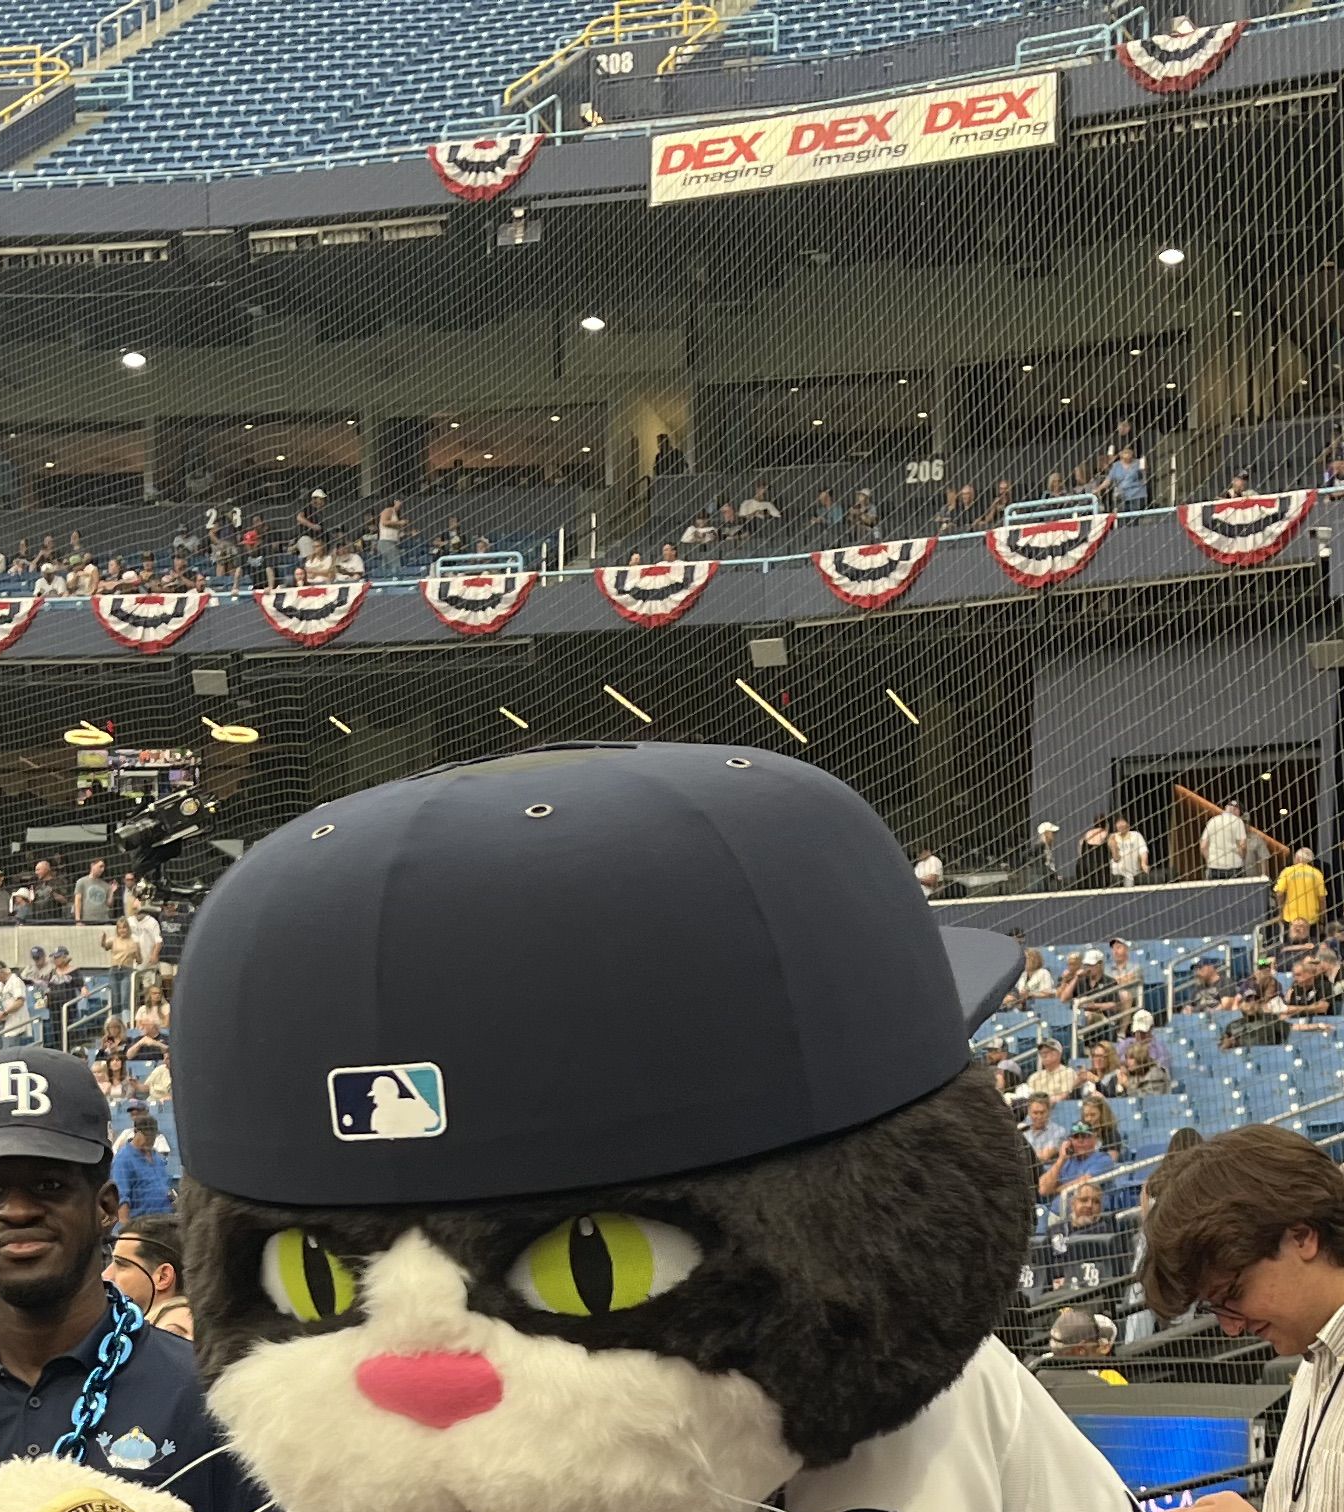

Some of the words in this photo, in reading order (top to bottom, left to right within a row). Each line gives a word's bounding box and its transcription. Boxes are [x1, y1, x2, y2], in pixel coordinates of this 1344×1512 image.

[657, 131, 766, 175] DEX
[786, 110, 899, 157] DEX
[922, 87, 1040, 135] DEX
[682, 164, 774, 187] imaging
[812, 142, 908, 168] imaging
[949, 121, 1048, 147] imaging
[906, 459, 944, 483] 206
[205, 507, 242, 529] 28
